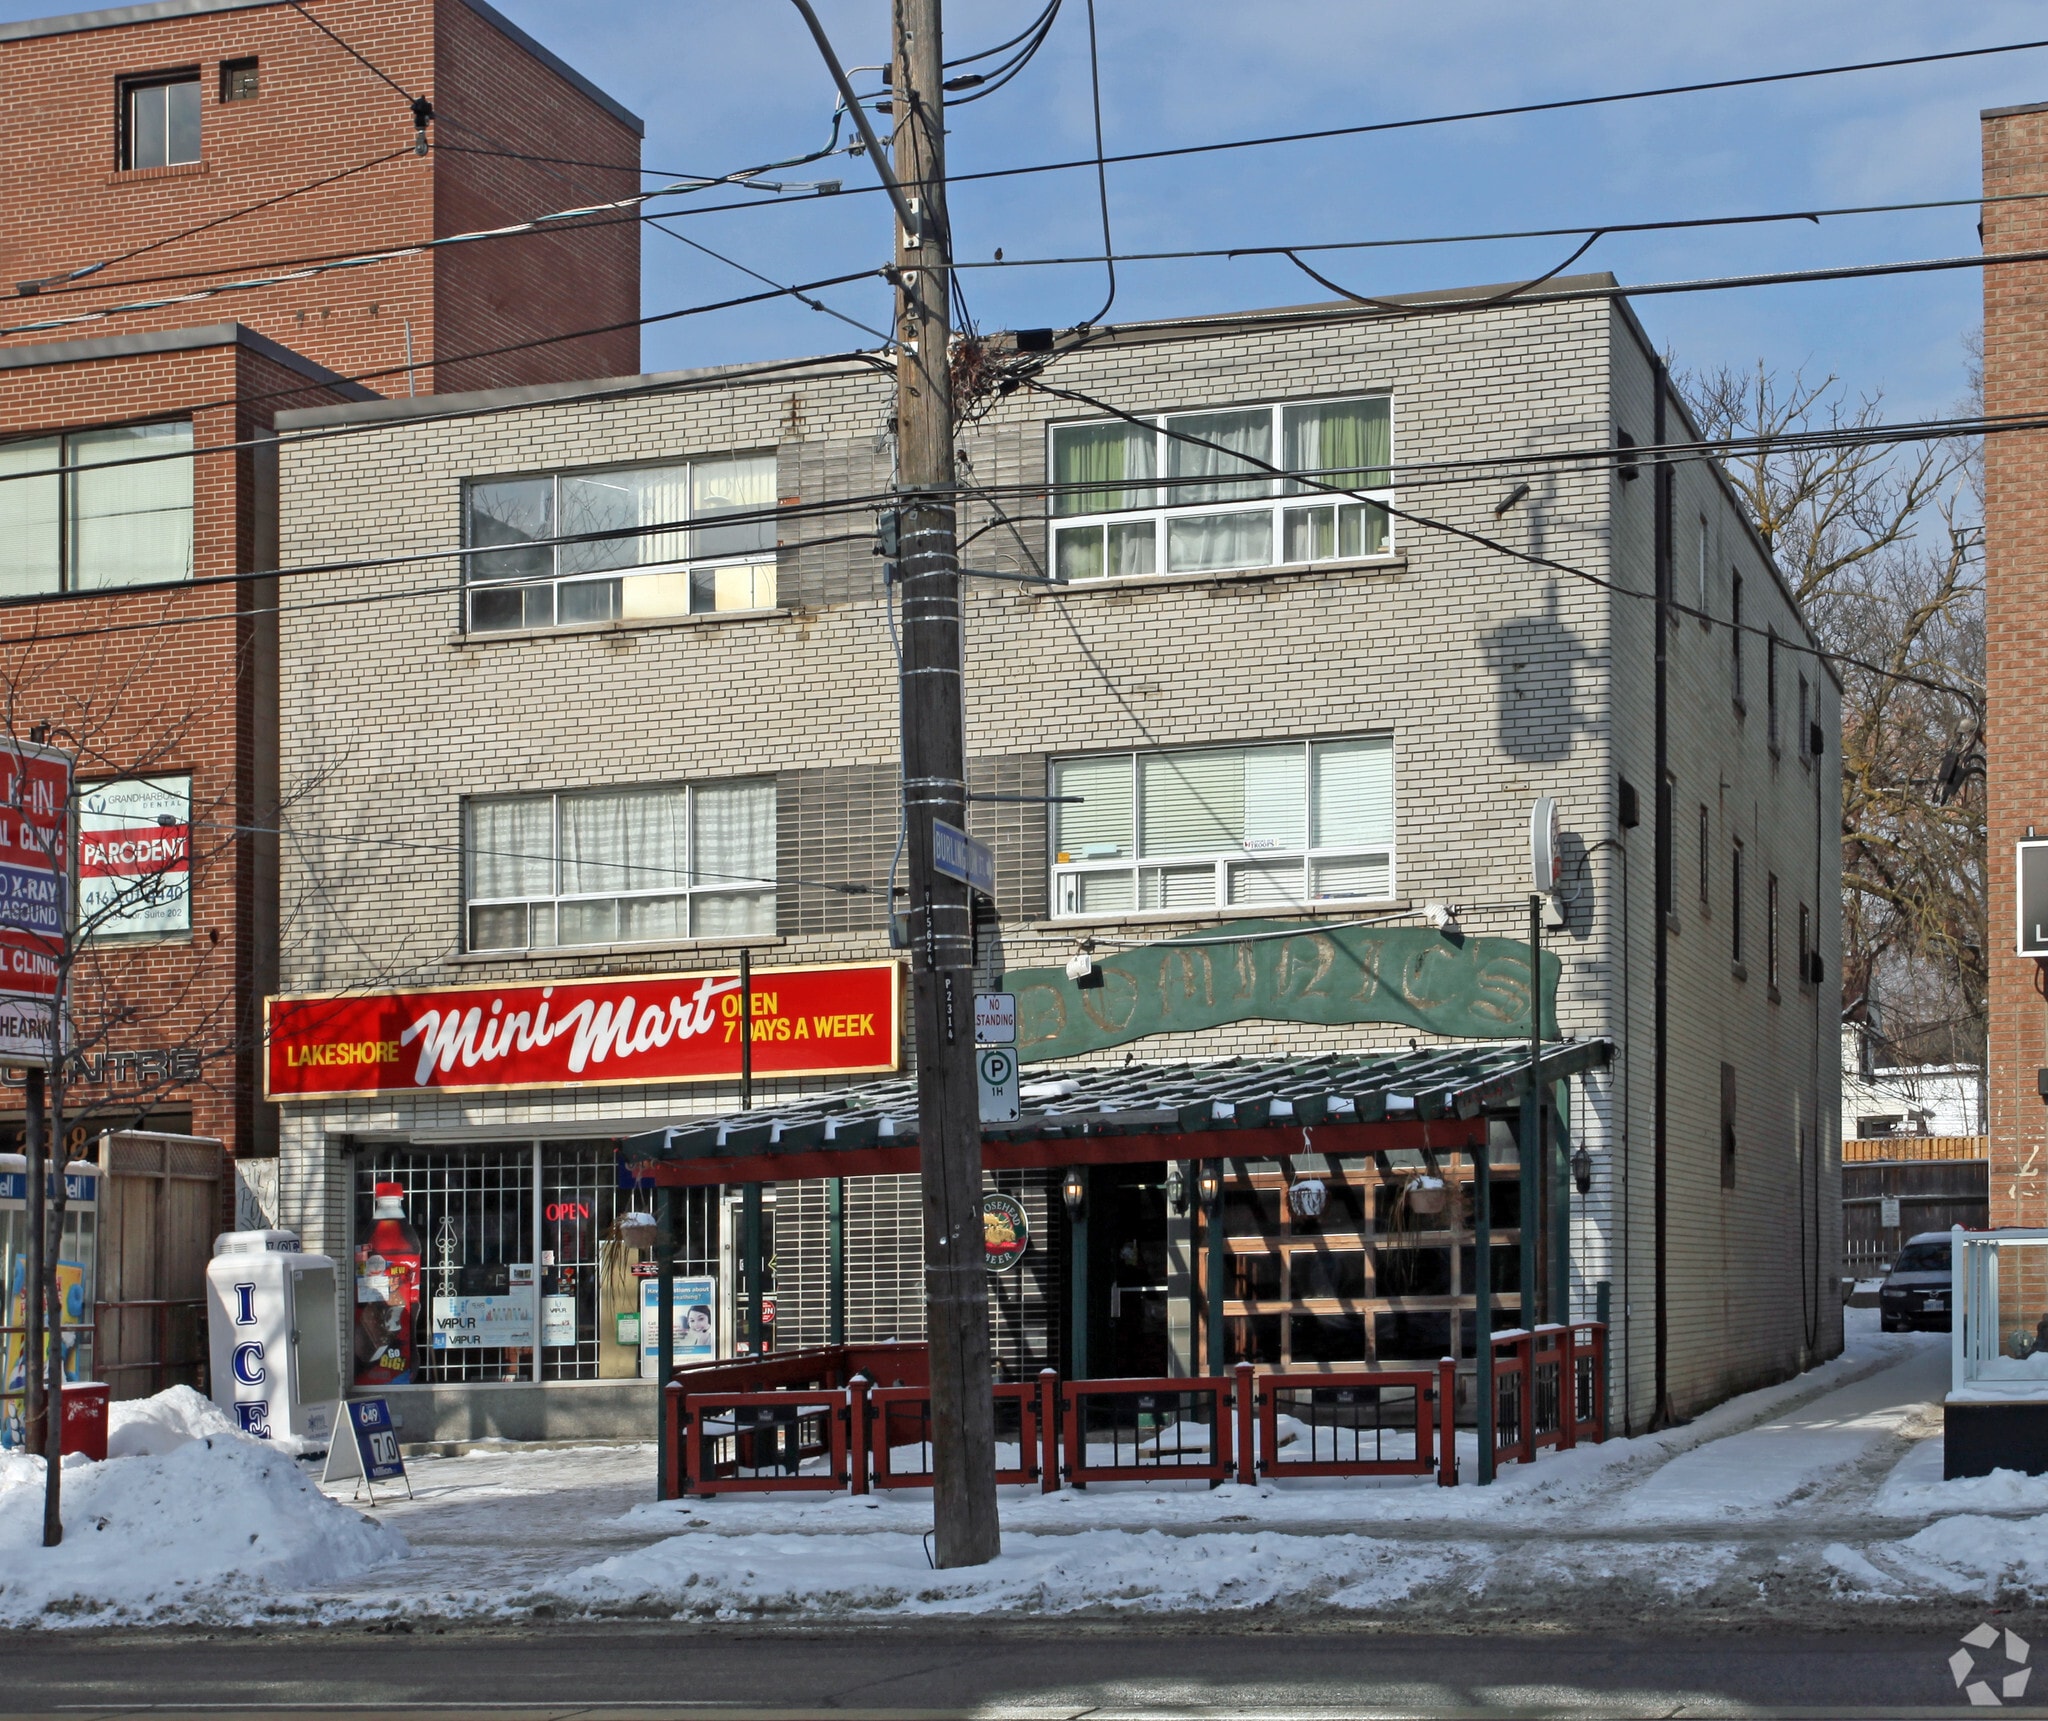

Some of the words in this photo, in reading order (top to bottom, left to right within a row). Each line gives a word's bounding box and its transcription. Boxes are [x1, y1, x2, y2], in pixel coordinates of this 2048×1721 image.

[108, 791, 182, 804] GRANDHARBOUR
[143, 801, 182, 809] DENTAL
[20, 823, 63, 856] CLINIC
[84, 838, 186, 866] PARODENT
[11, 875, 57, 903] X-RAY
[145, 910, 165, 919] Suite
[167, 909, 182, 918] 202
[13, 950, 60, 977] CLINIC
[945, 979, 953, 1040] P2314
[989, 999, 1000, 1011] NO
[1, 1015, 61, 1041] HEARIN
[724, 1020, 735, 1043] 7
[794, 1017, 809, 1040] A
[813, 1013, 875, 1039] WEEK
[976, 1014, 1013, 1026] STANDING
[288, 1041, 399, 1067] LAKESHORE
[401, 986, 555, 1087] Mini
[553, 978, 742, 1073] Mart
[992, 1087, 1003, 1097] 1H
[545, 1202, 590, 1221] OPEN
[436, 1317, 476, 1329] VAPUR
[449, 1335, 481, 1344] VAPUR
[232, 1283, 271, 1440] ICE
